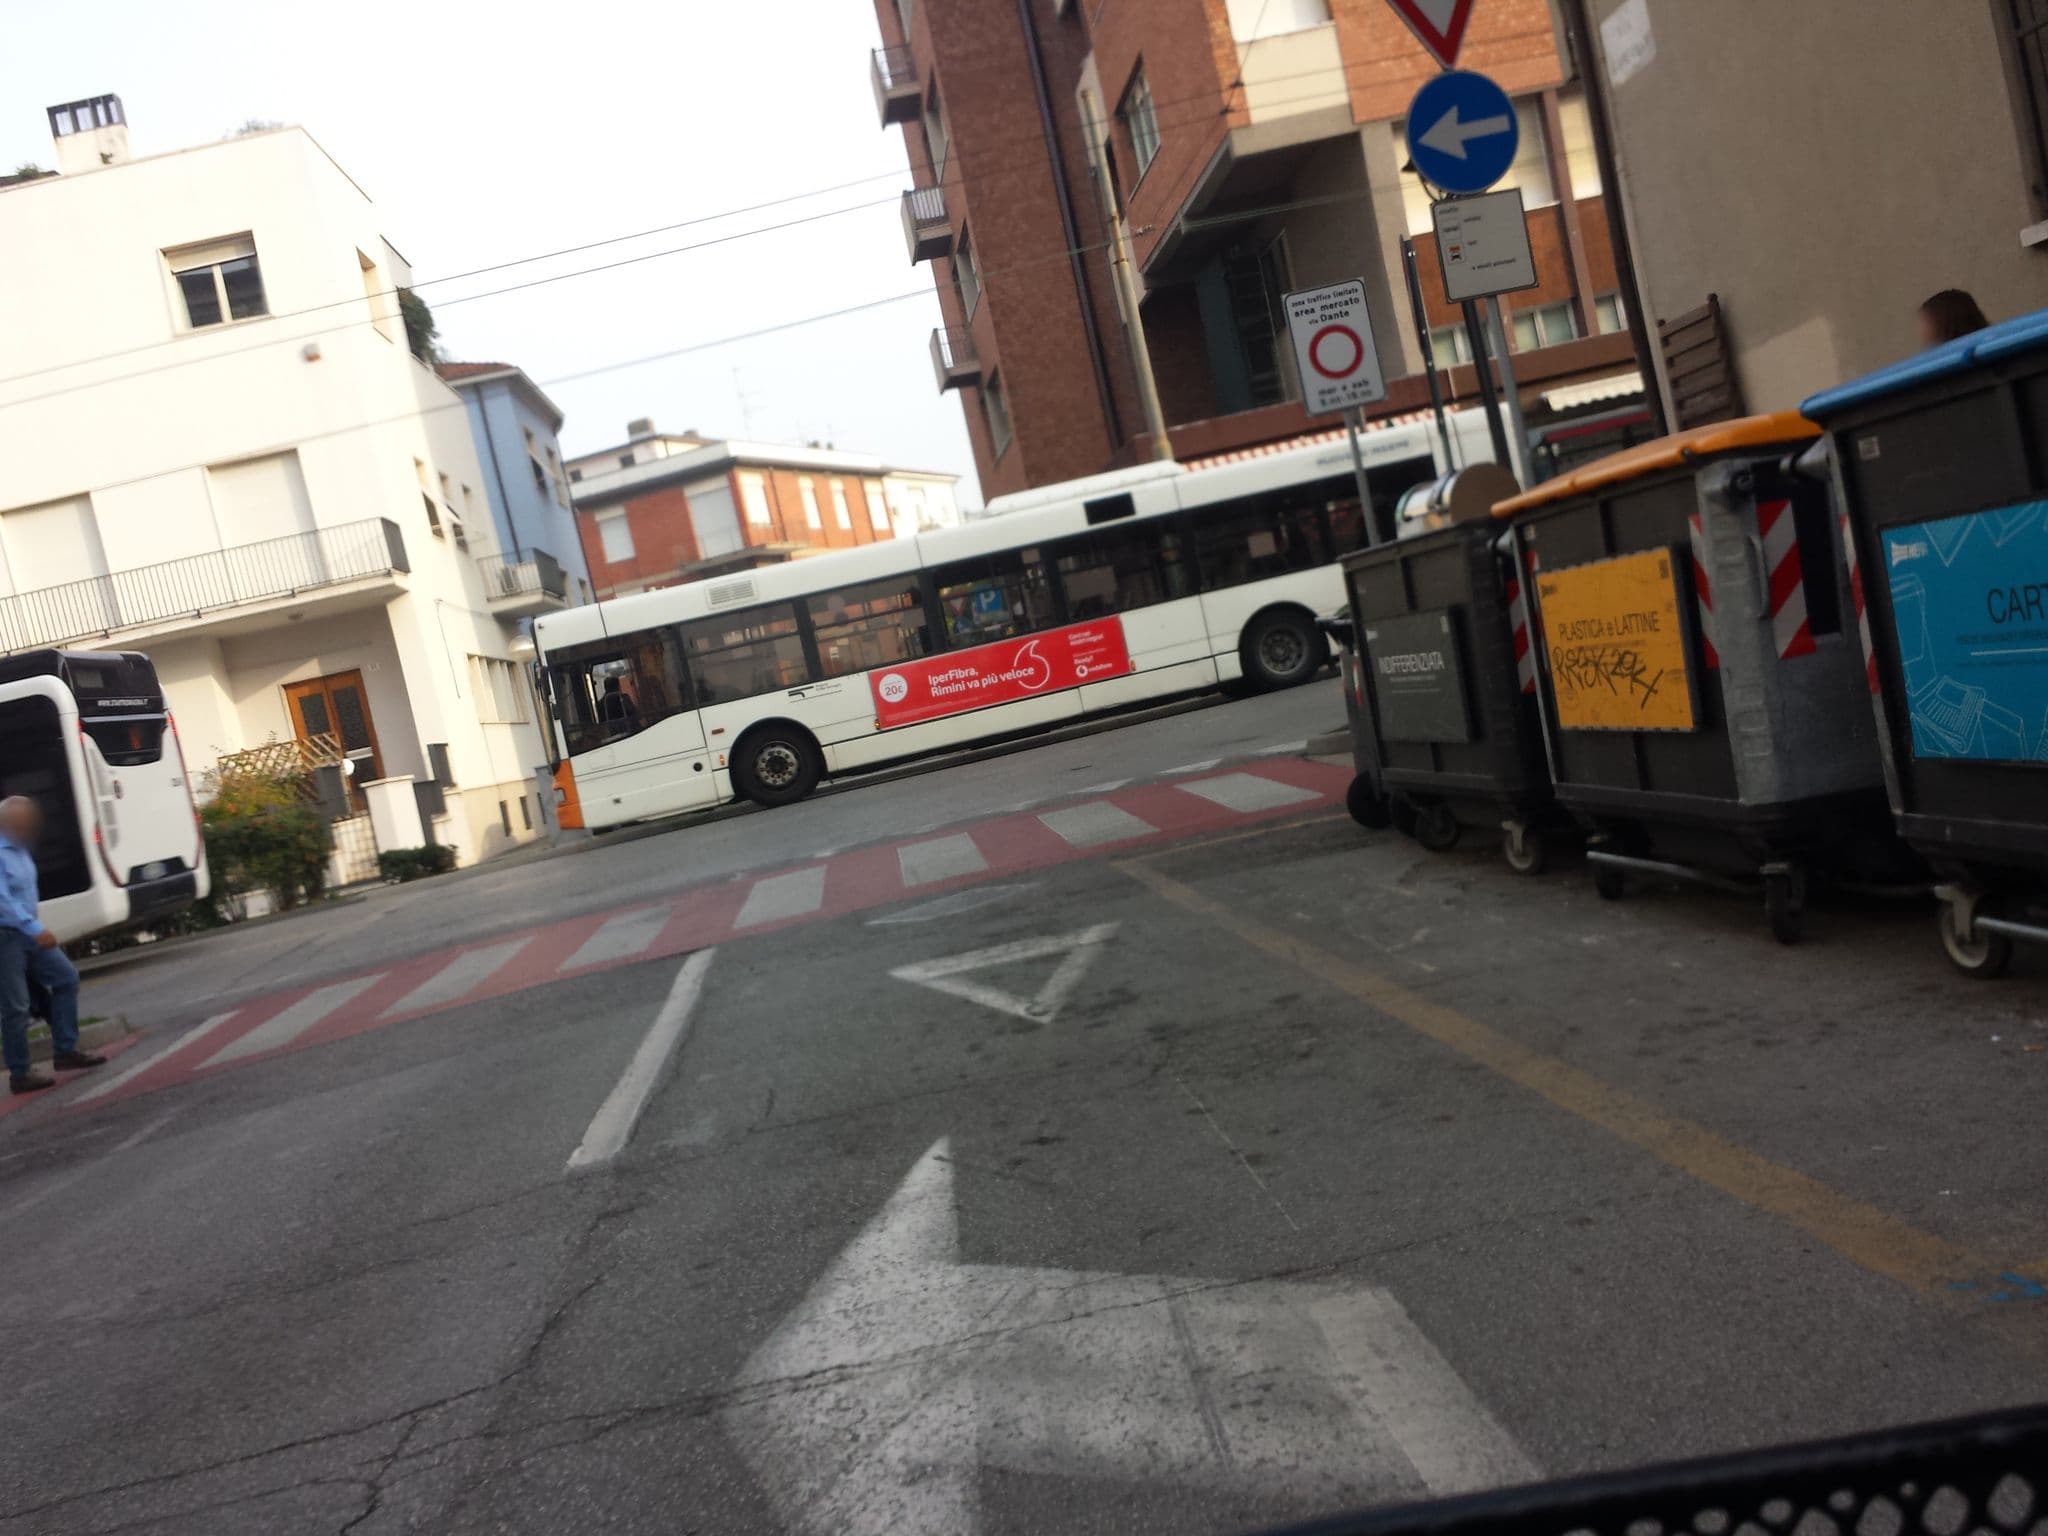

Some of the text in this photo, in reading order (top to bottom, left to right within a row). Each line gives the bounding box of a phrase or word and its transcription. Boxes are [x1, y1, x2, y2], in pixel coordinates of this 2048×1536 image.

[1294, 297, 1360, 318] area mercato
[1307, 294, 1331, 304] traffico
[1308, 310, 1350, 325] via Dante
[1557, 610, 1661, 642] PLASTICA e LATTINE
[928, 666, 979, 686] IperFibra,
[930, 665, 1035, 698] Rimini va più veloce
